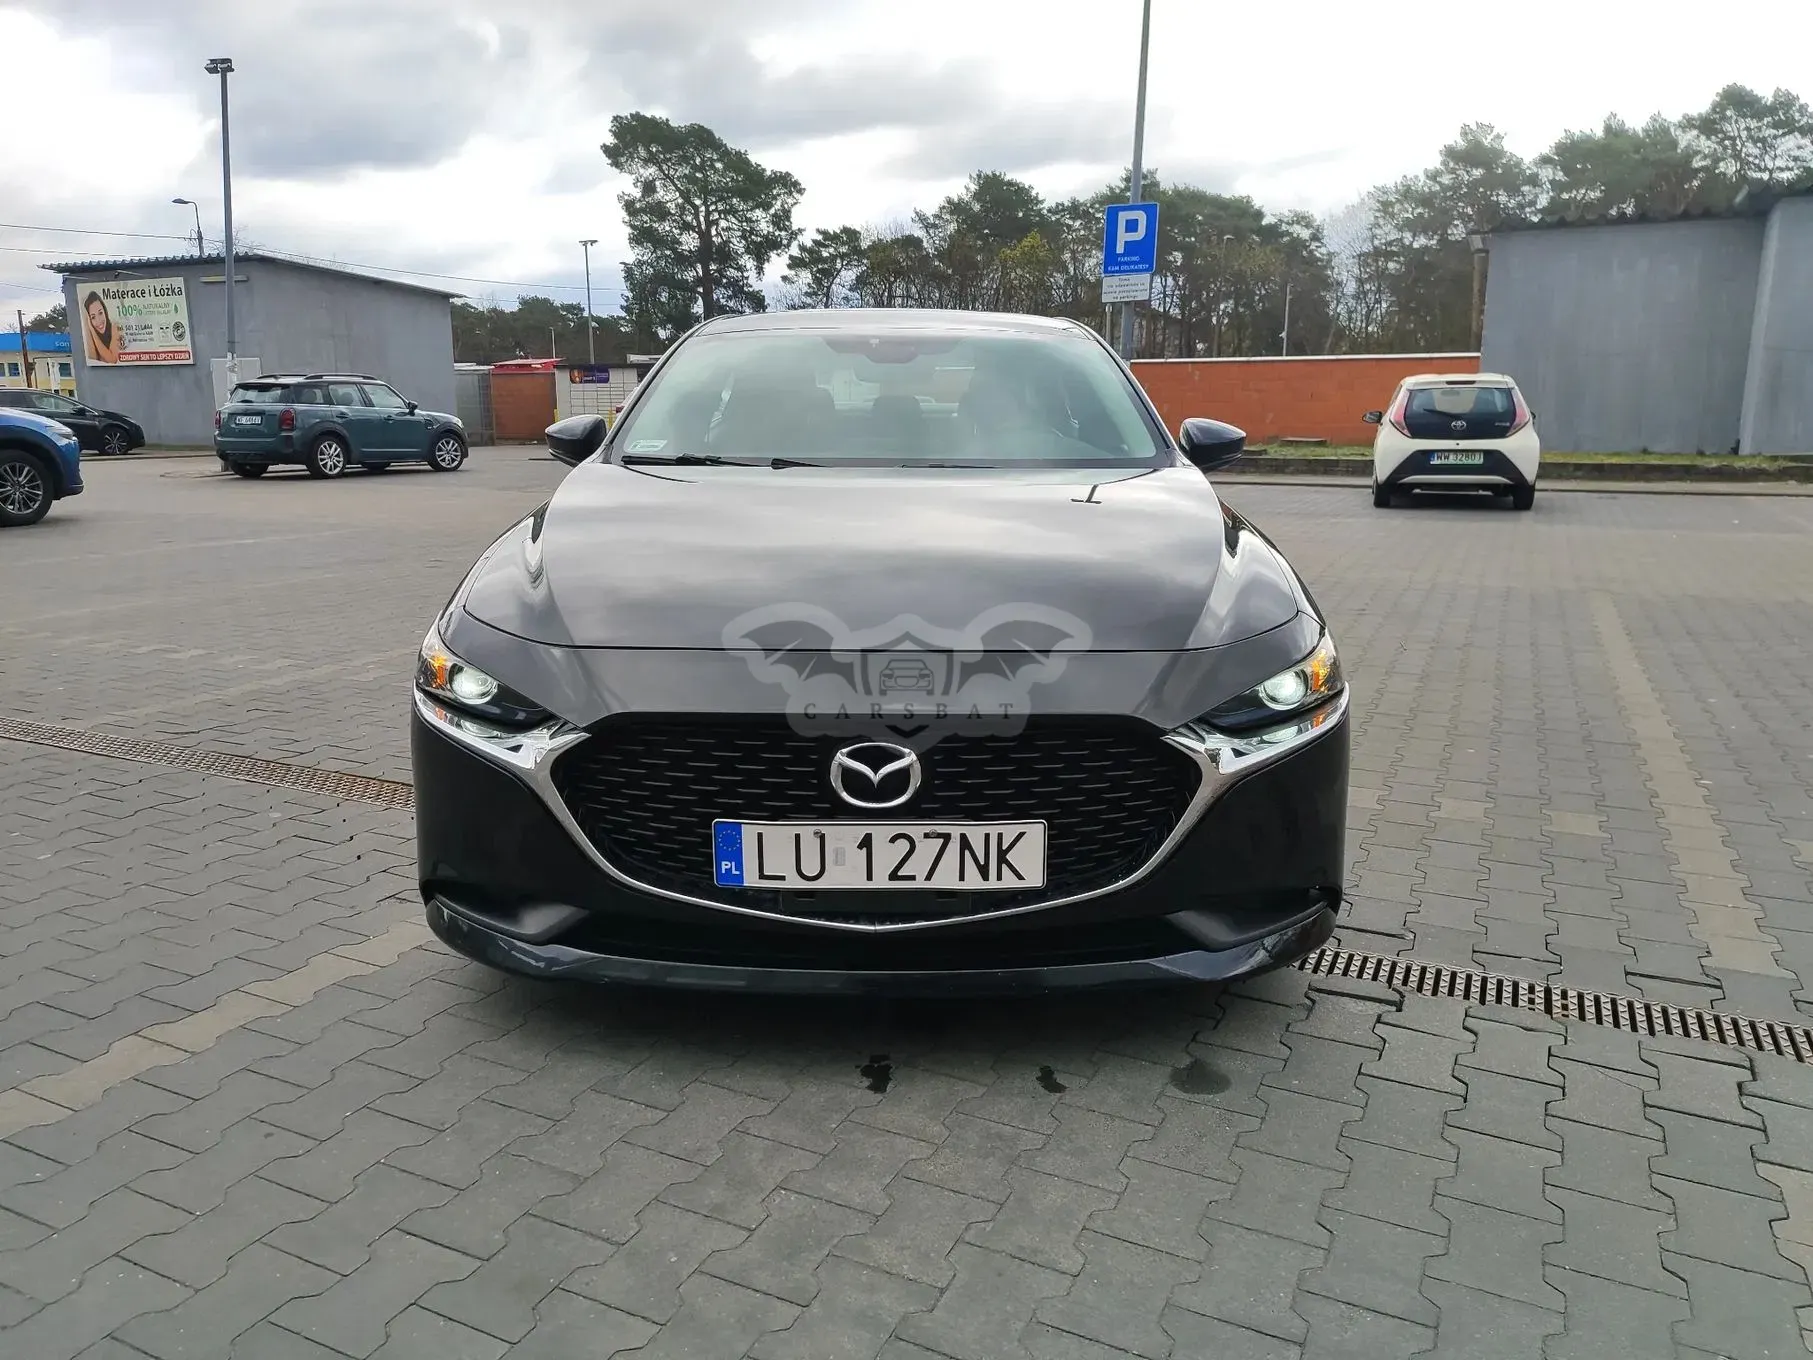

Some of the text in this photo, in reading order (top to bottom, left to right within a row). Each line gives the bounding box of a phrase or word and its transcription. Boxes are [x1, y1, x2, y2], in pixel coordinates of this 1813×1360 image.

[1116, 210, 1147, 254] P
[102, 283, 183, 300] Materace i Łóżka
[117, 304, 143, 317] 100%
[757, 831, 1028, 882] LU 127NK
[721, 861, 740, 875] PL
